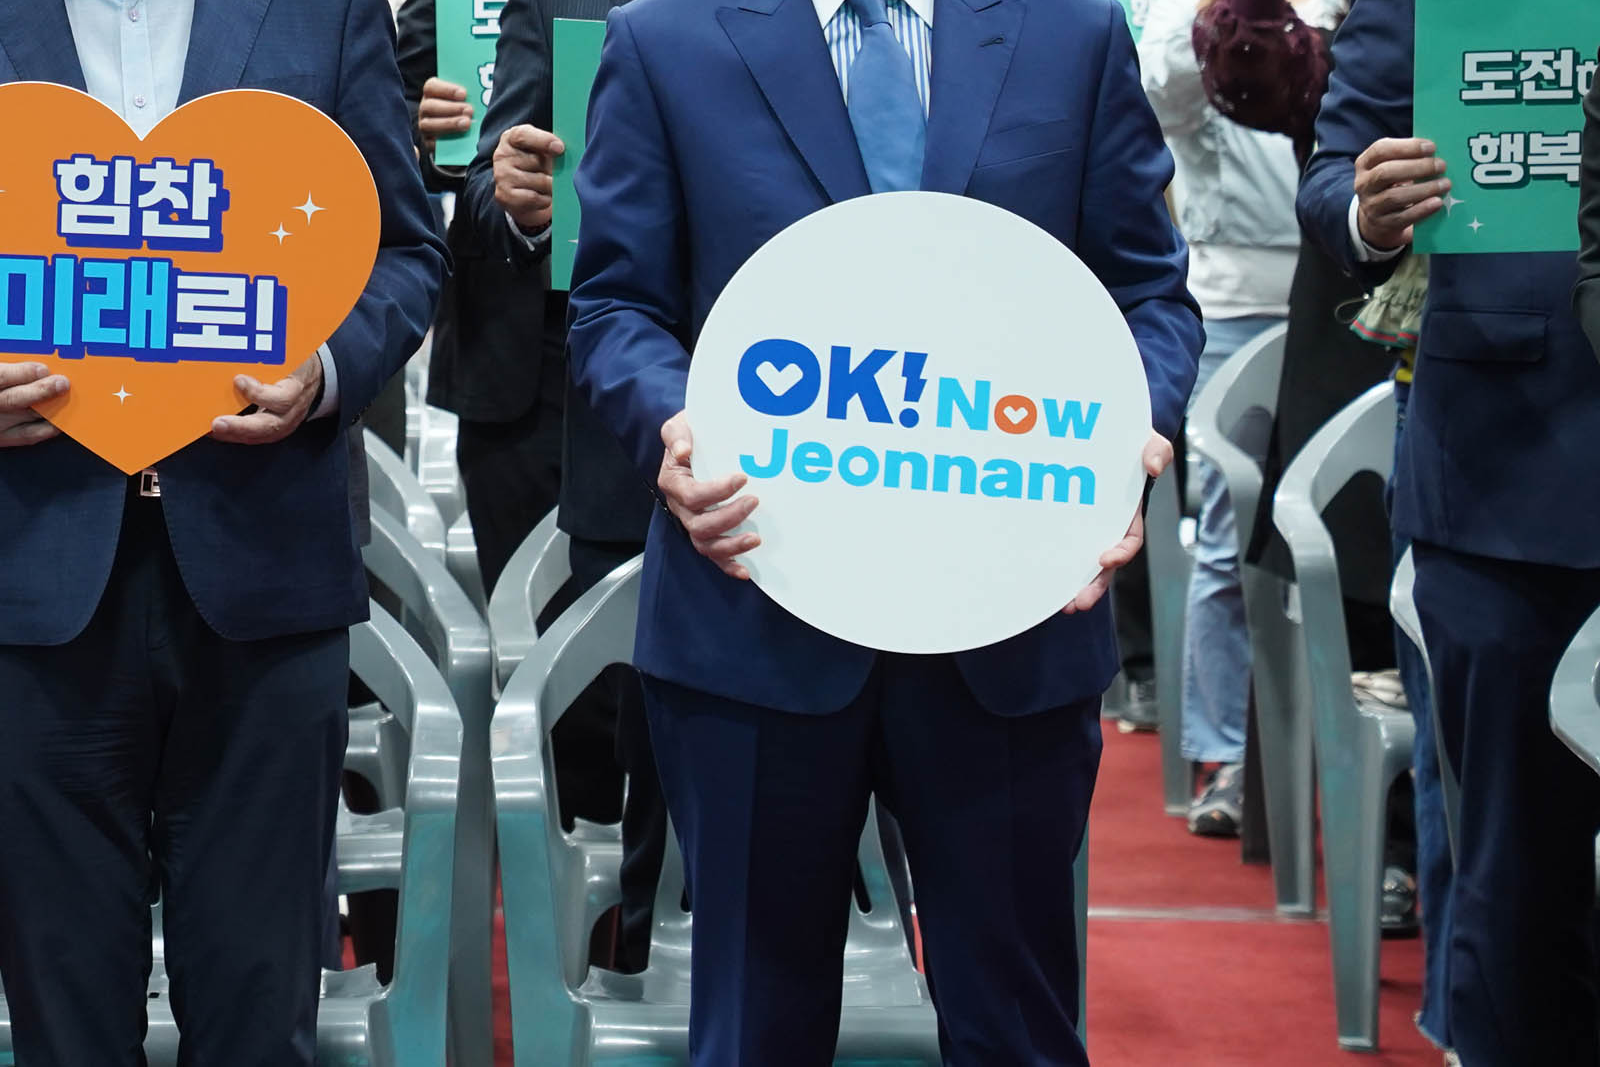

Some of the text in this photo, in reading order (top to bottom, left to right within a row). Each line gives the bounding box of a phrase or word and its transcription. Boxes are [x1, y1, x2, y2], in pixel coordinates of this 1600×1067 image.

[1460, 48, 1597, 102] 도전
[1468, 131, 1582, 186] 행복
[54, 155, 227, 250] 힘찬
[737, 338, 929, 429] OK!
[738, 428, 1097, 506] Jeonnam
